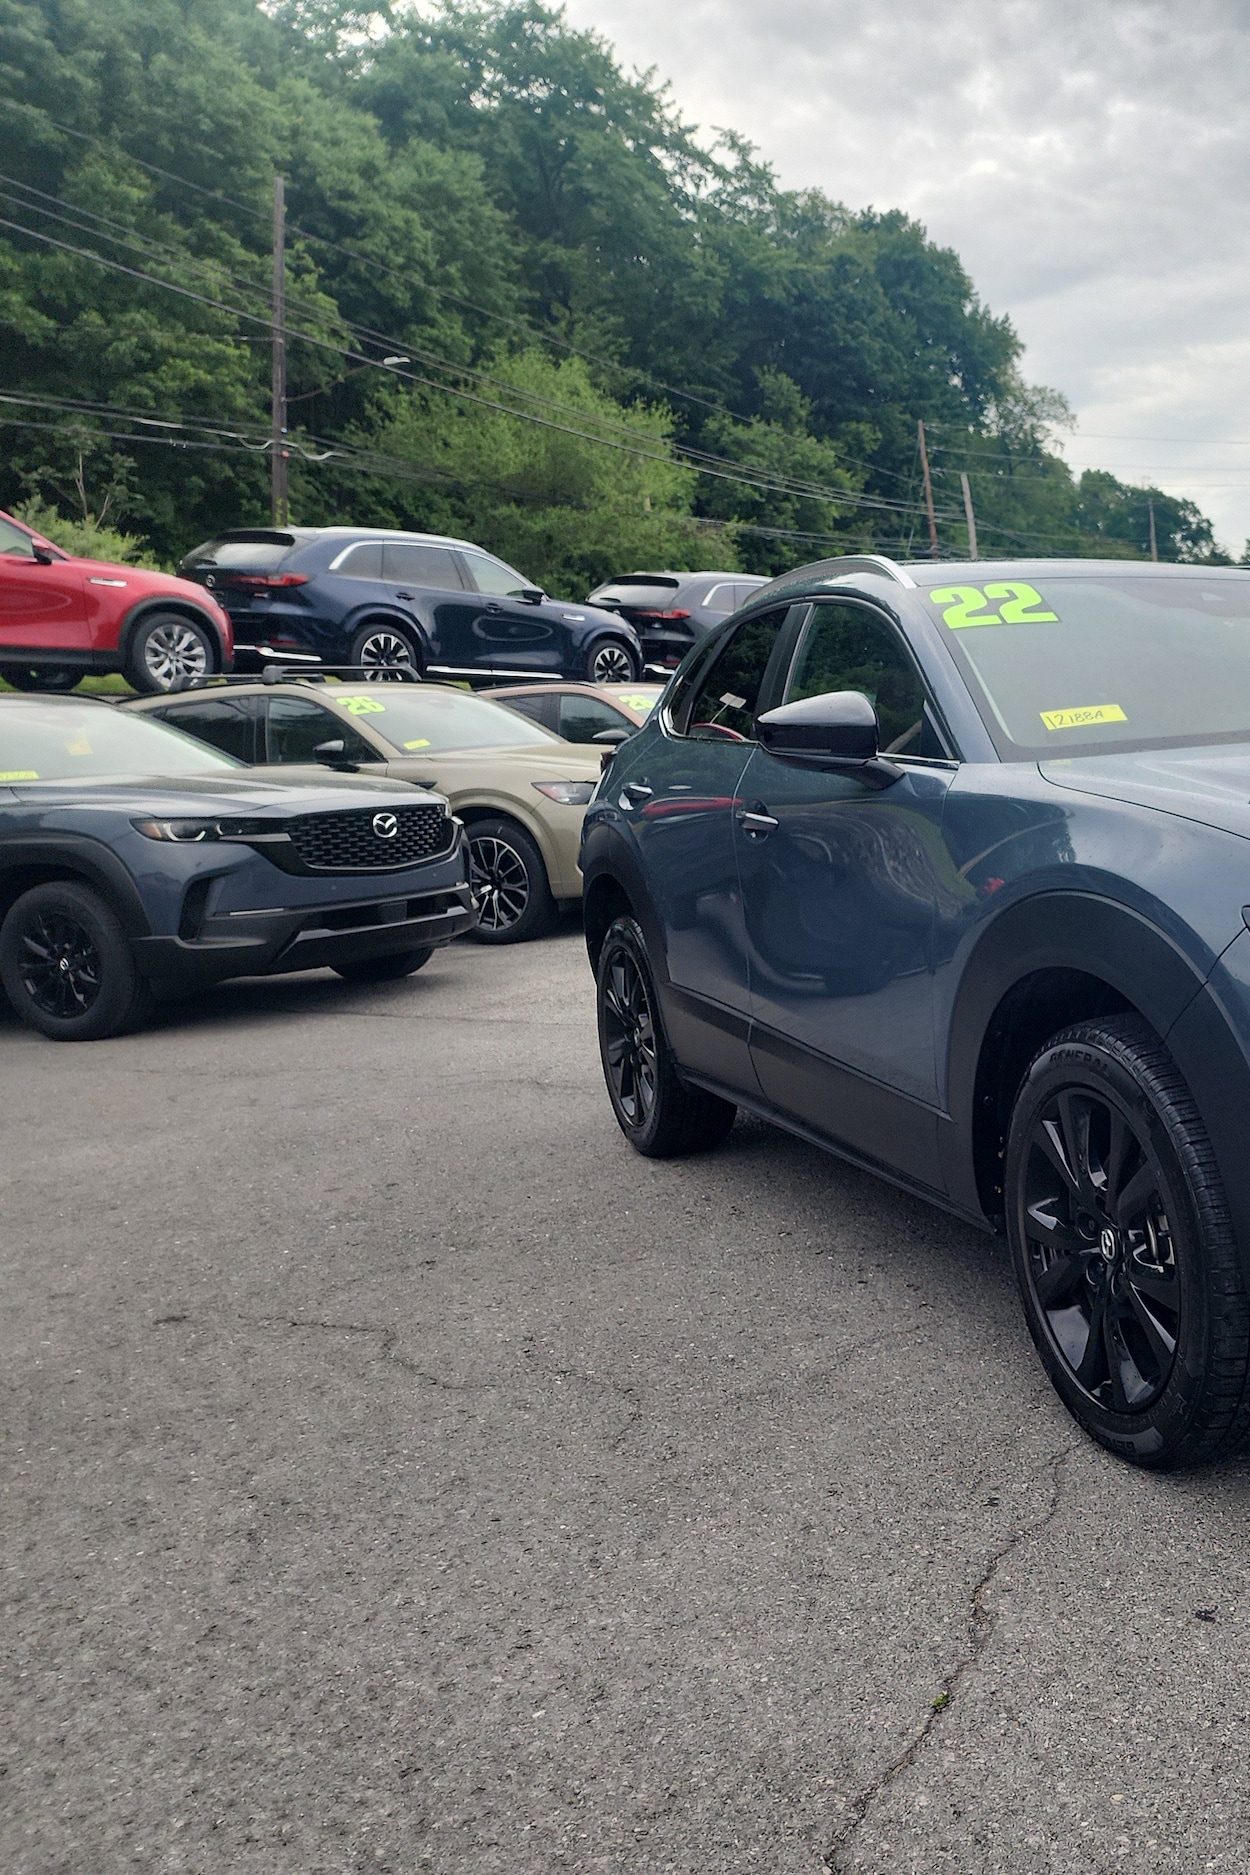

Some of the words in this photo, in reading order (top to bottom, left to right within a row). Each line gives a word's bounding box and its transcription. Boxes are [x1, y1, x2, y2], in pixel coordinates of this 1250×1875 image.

[929, 583, 1059, 629] 22
[336, 695, 387, 716] 26
[618, 694, 655, 711] 26
